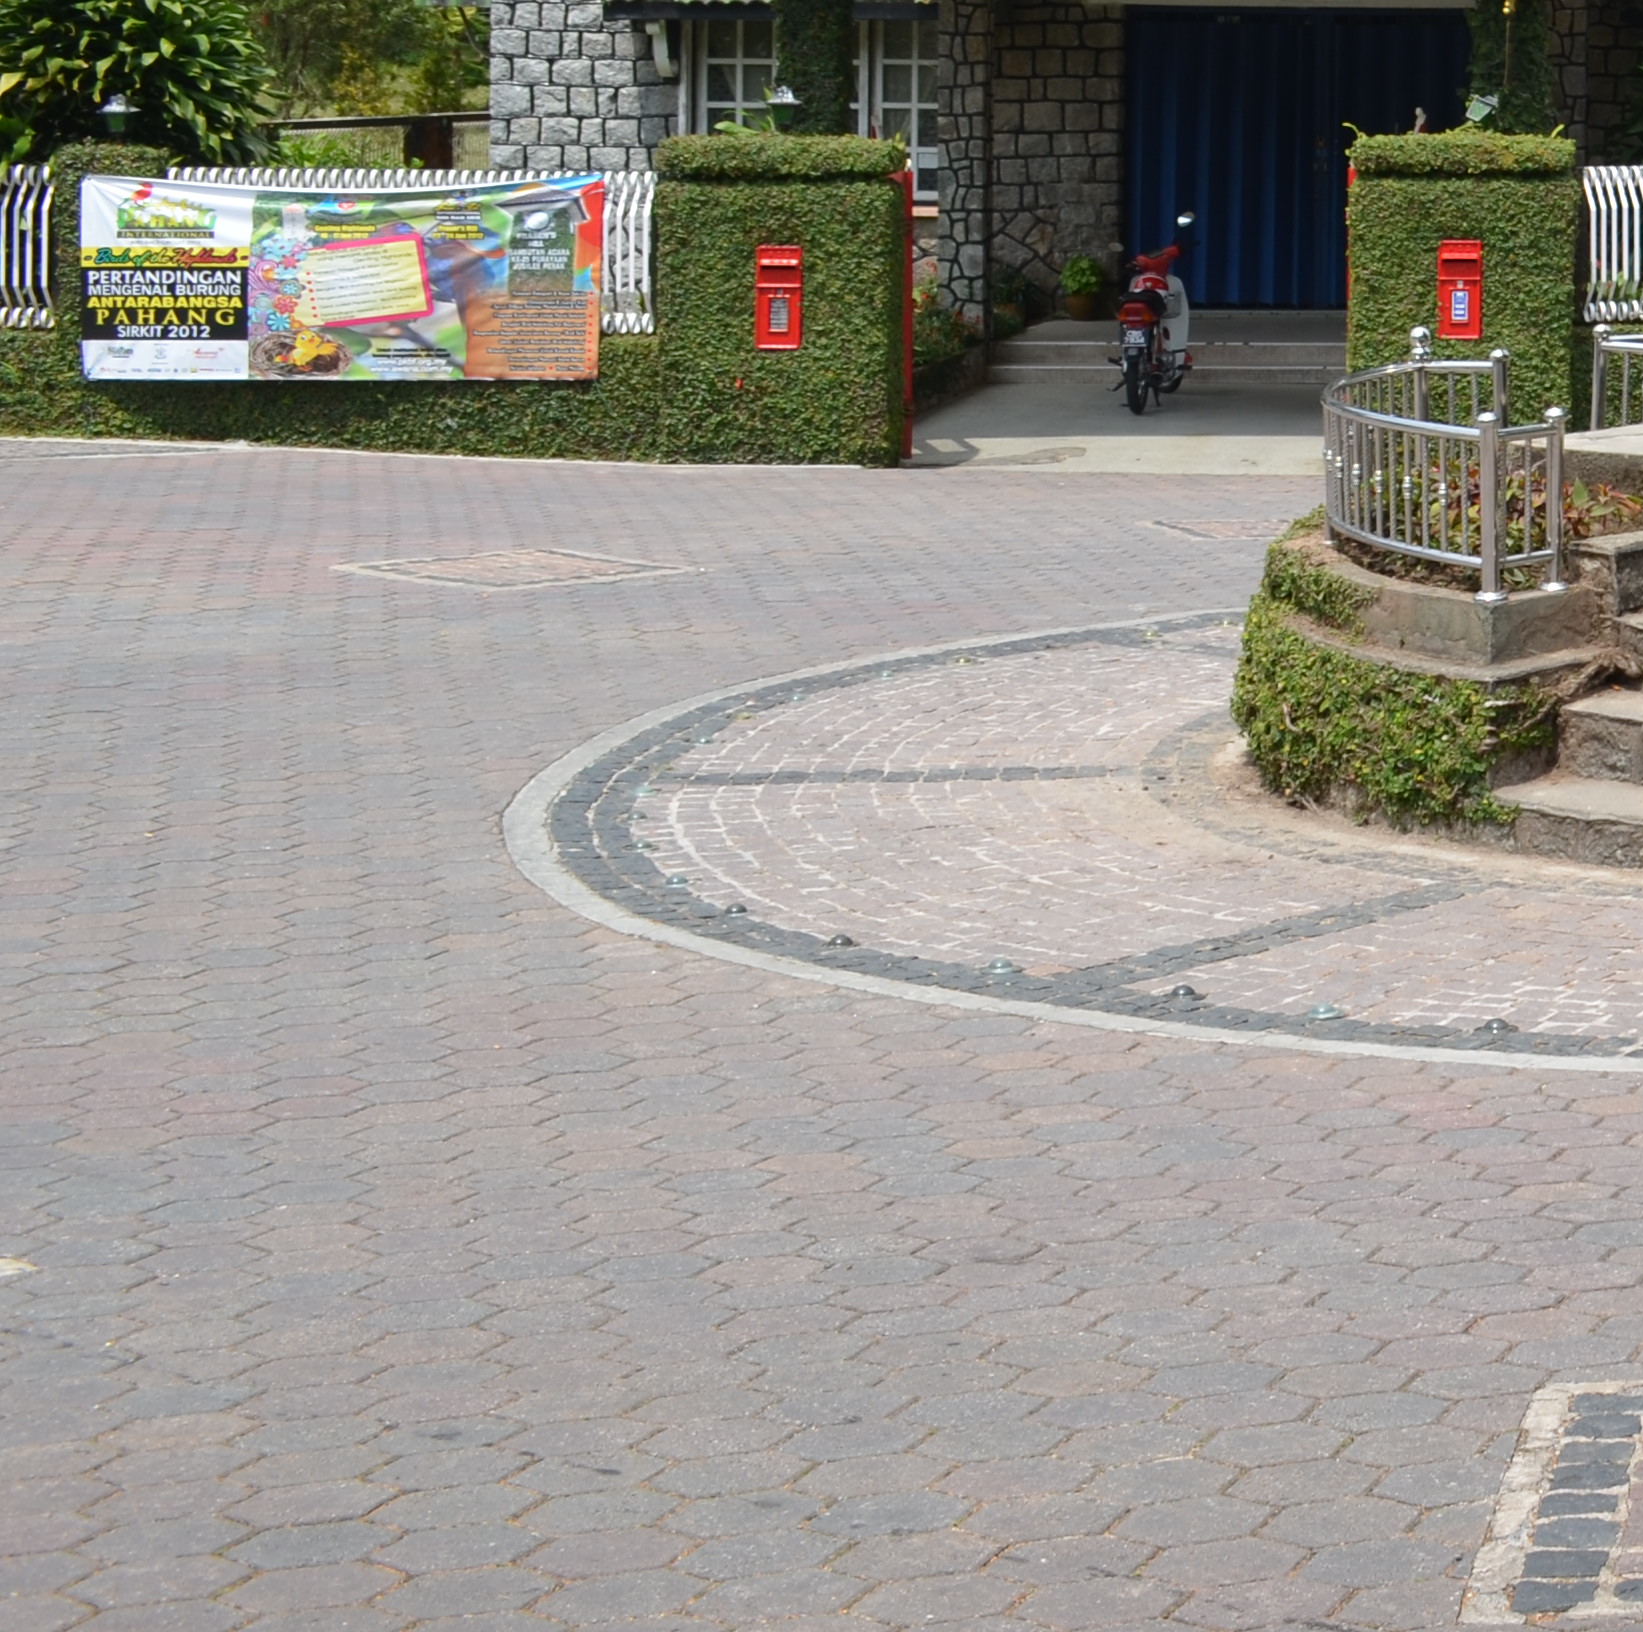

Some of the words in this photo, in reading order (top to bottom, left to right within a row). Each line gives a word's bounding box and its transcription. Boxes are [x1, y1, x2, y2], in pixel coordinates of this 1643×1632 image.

[121, 231, 211, 239] INTERNATIONAL
[87, 270, 242, 284] PERTANDINGAN
[88, 284, 172, 296] MENGENAL
[175, 284, 241, 296] BURUNG
[87, 296, 243, 308] ANTARABANGSA
[96, 308, 236, 325] PAHANG
[117, 325, 164, 338] SIRKIT
[168, 325, 211, 338] 2012
